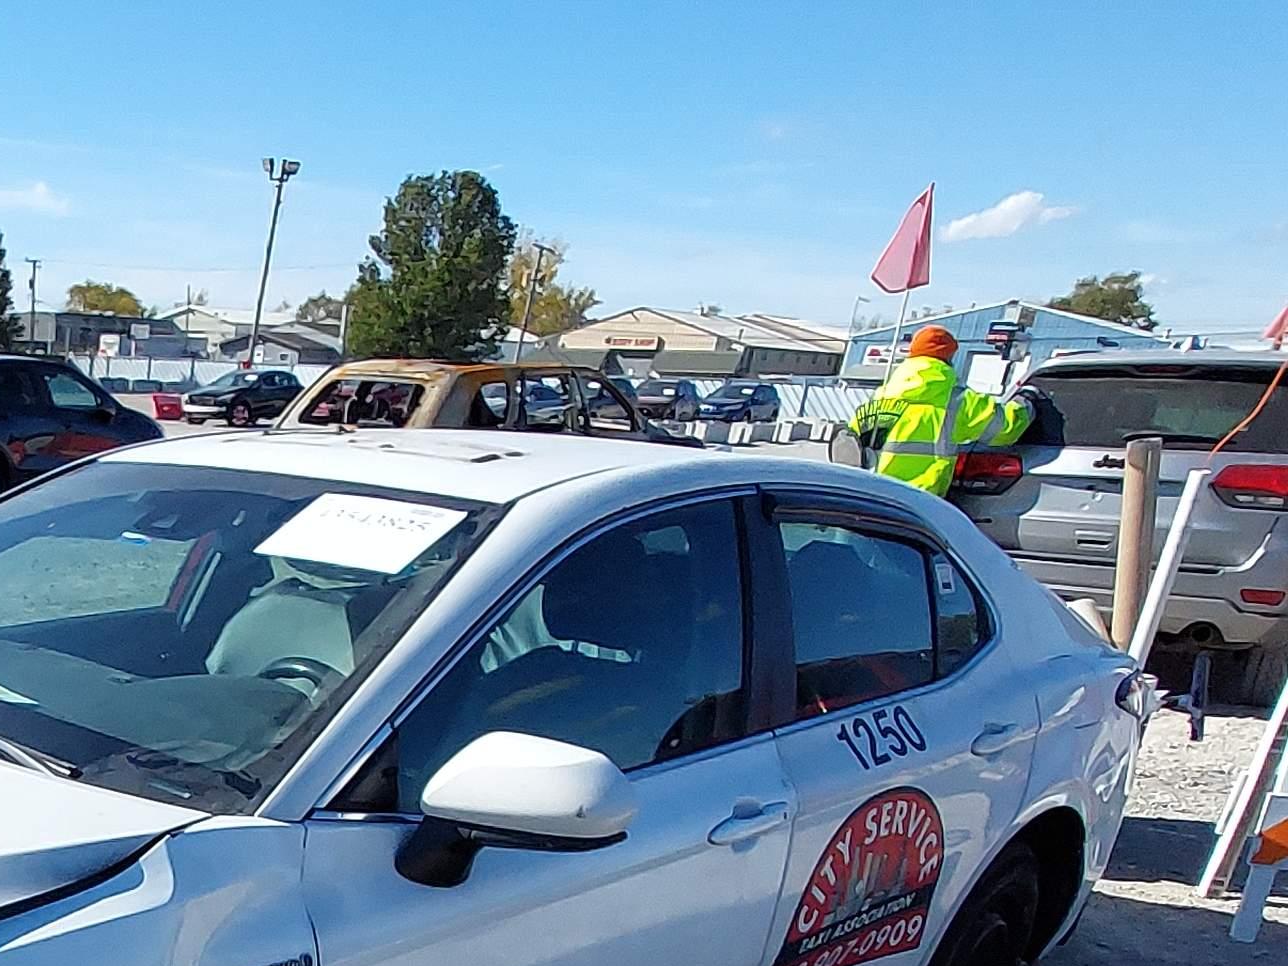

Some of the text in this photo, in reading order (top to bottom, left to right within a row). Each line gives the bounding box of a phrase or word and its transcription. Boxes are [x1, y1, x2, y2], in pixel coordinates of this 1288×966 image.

[836, 705, 927, 770] 1250
[798, 800, 940, 933] CITY SERVICE
